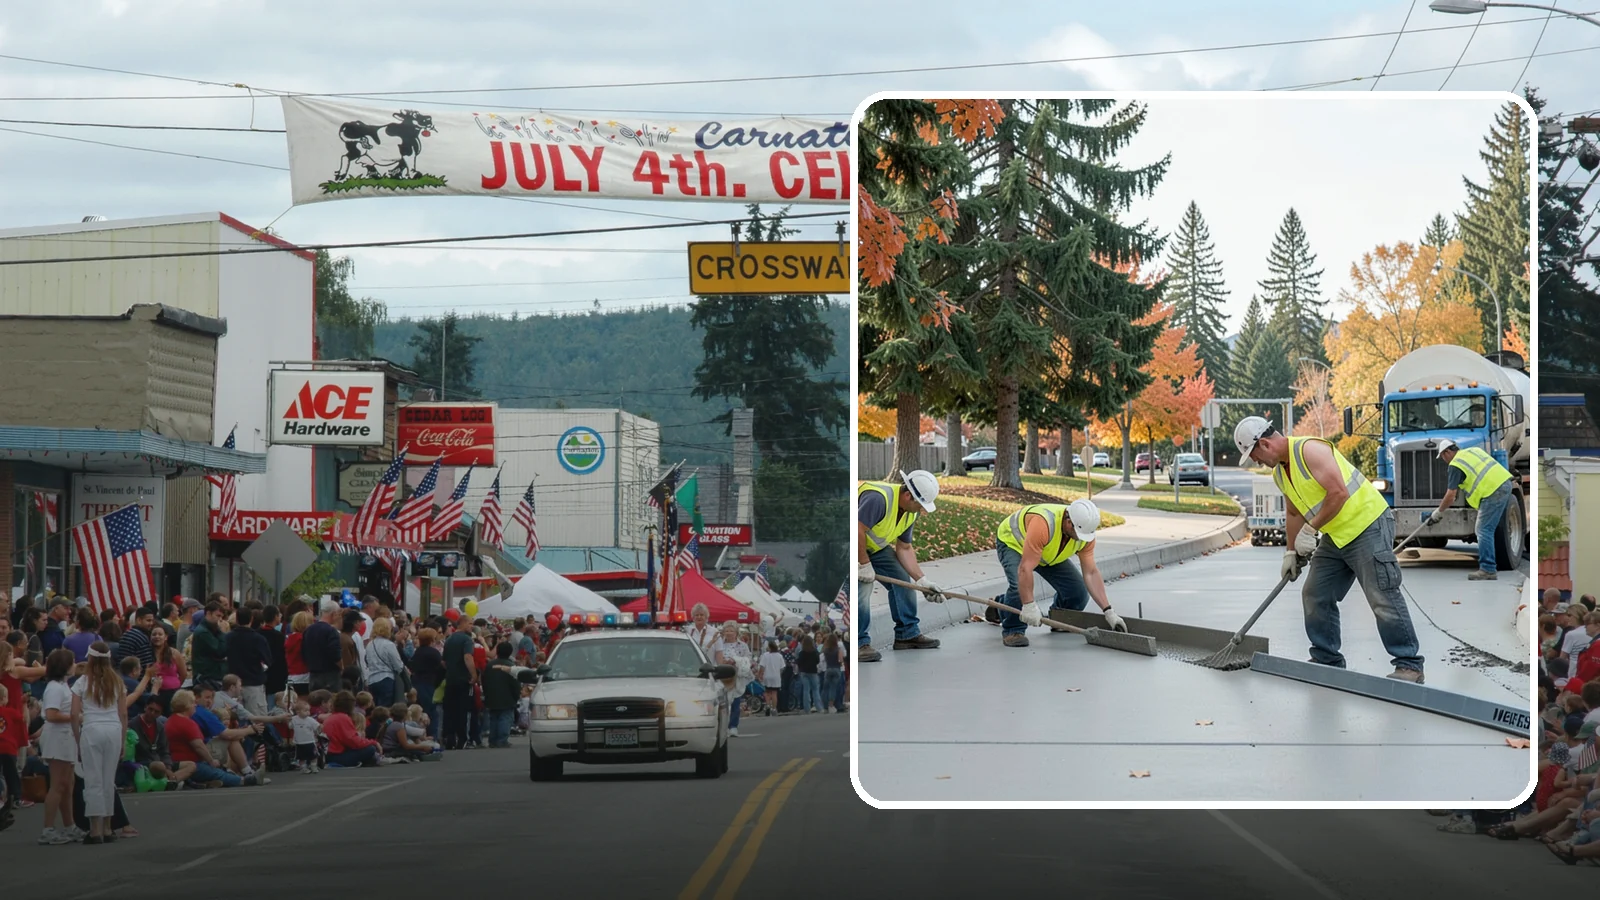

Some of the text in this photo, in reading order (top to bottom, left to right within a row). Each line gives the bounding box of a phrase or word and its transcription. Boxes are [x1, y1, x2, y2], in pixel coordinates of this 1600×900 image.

[481, 141, 605, 193] JULY
[632, 149, 746, 198] 4th.
[697, 254, 850, 280] CROSSWA
[283, 380, 373, 420] ACE
[405, 409, 485, 422] CEDAR LOG
[283, 421, 371, 436] Hardware
[416, 428, 477, 447] Coca-Cola
[83, 485, 155, 495] St. Vincent de Paul
[688, 526, 741, 535] CRNATION
[699, 535, 730, 543] GLASS
